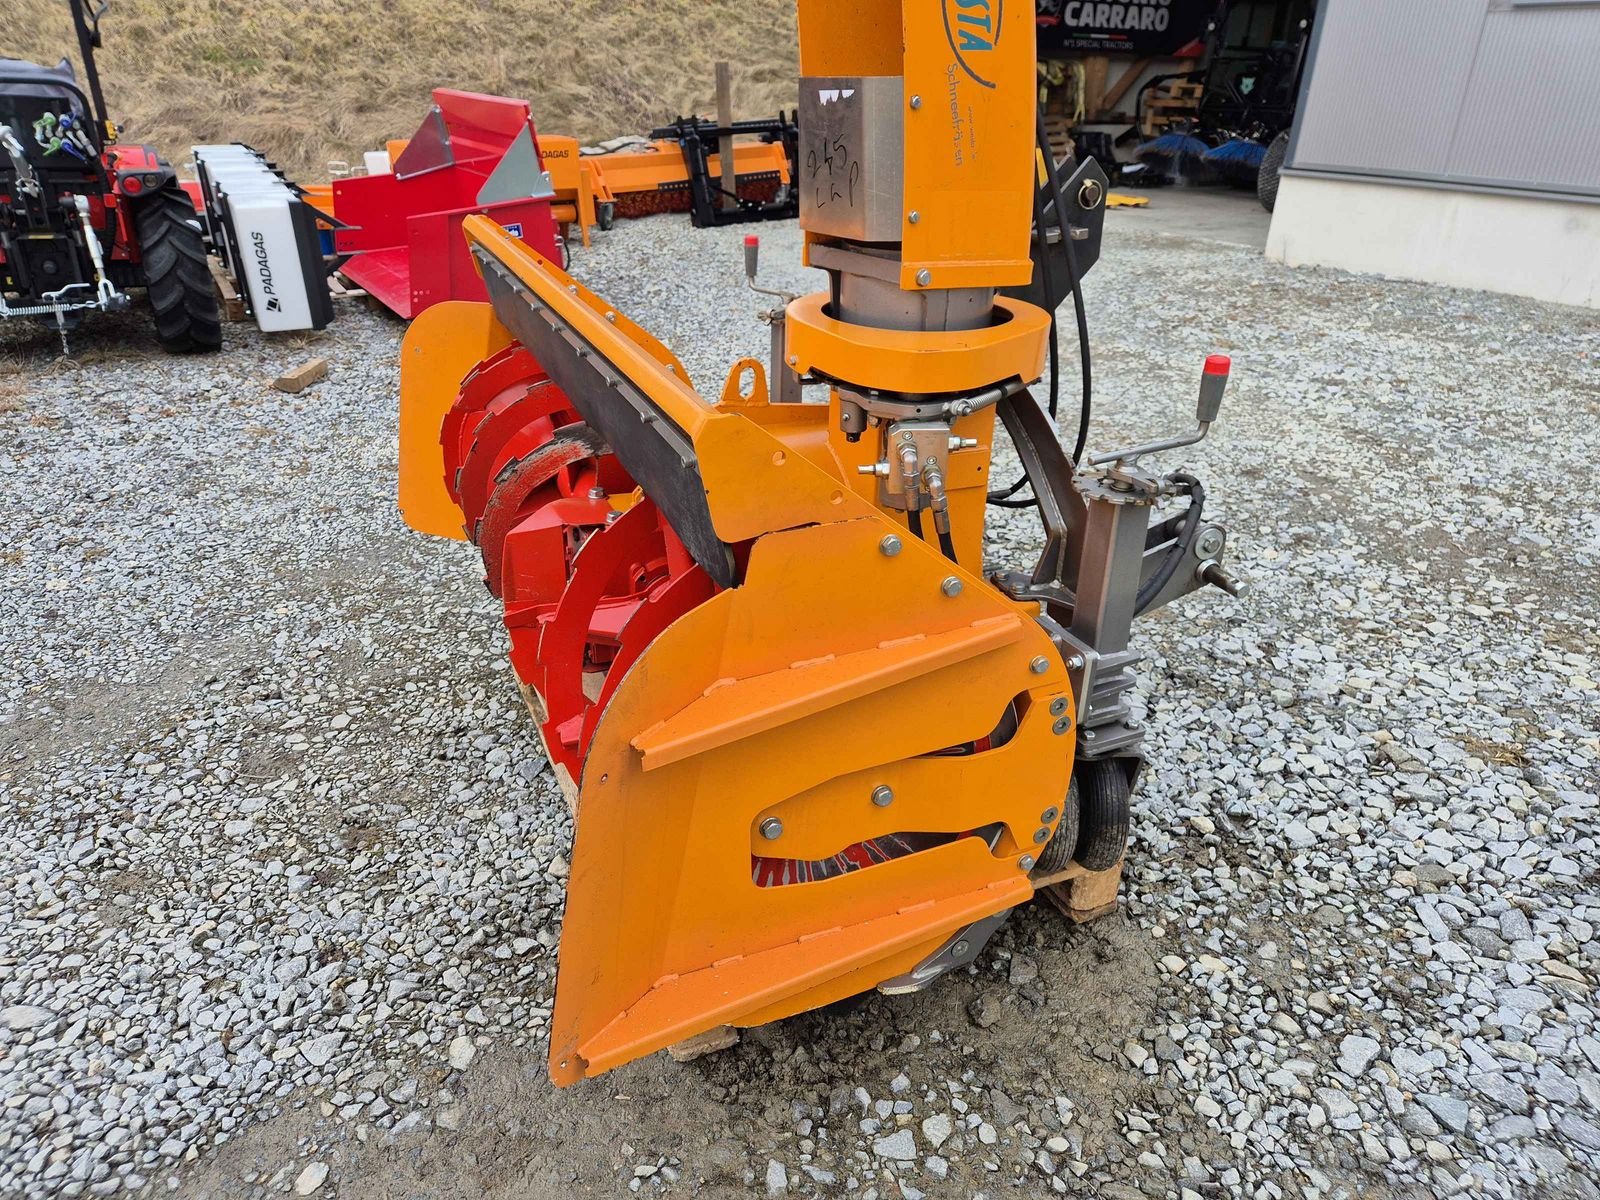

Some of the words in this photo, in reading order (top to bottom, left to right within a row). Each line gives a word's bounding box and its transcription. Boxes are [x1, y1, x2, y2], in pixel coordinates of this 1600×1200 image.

[1064, 1, 1170, 32] CARRARO
[807, 134, 848, 178] 245
[251, 231, 276, 295] PADAGAS
